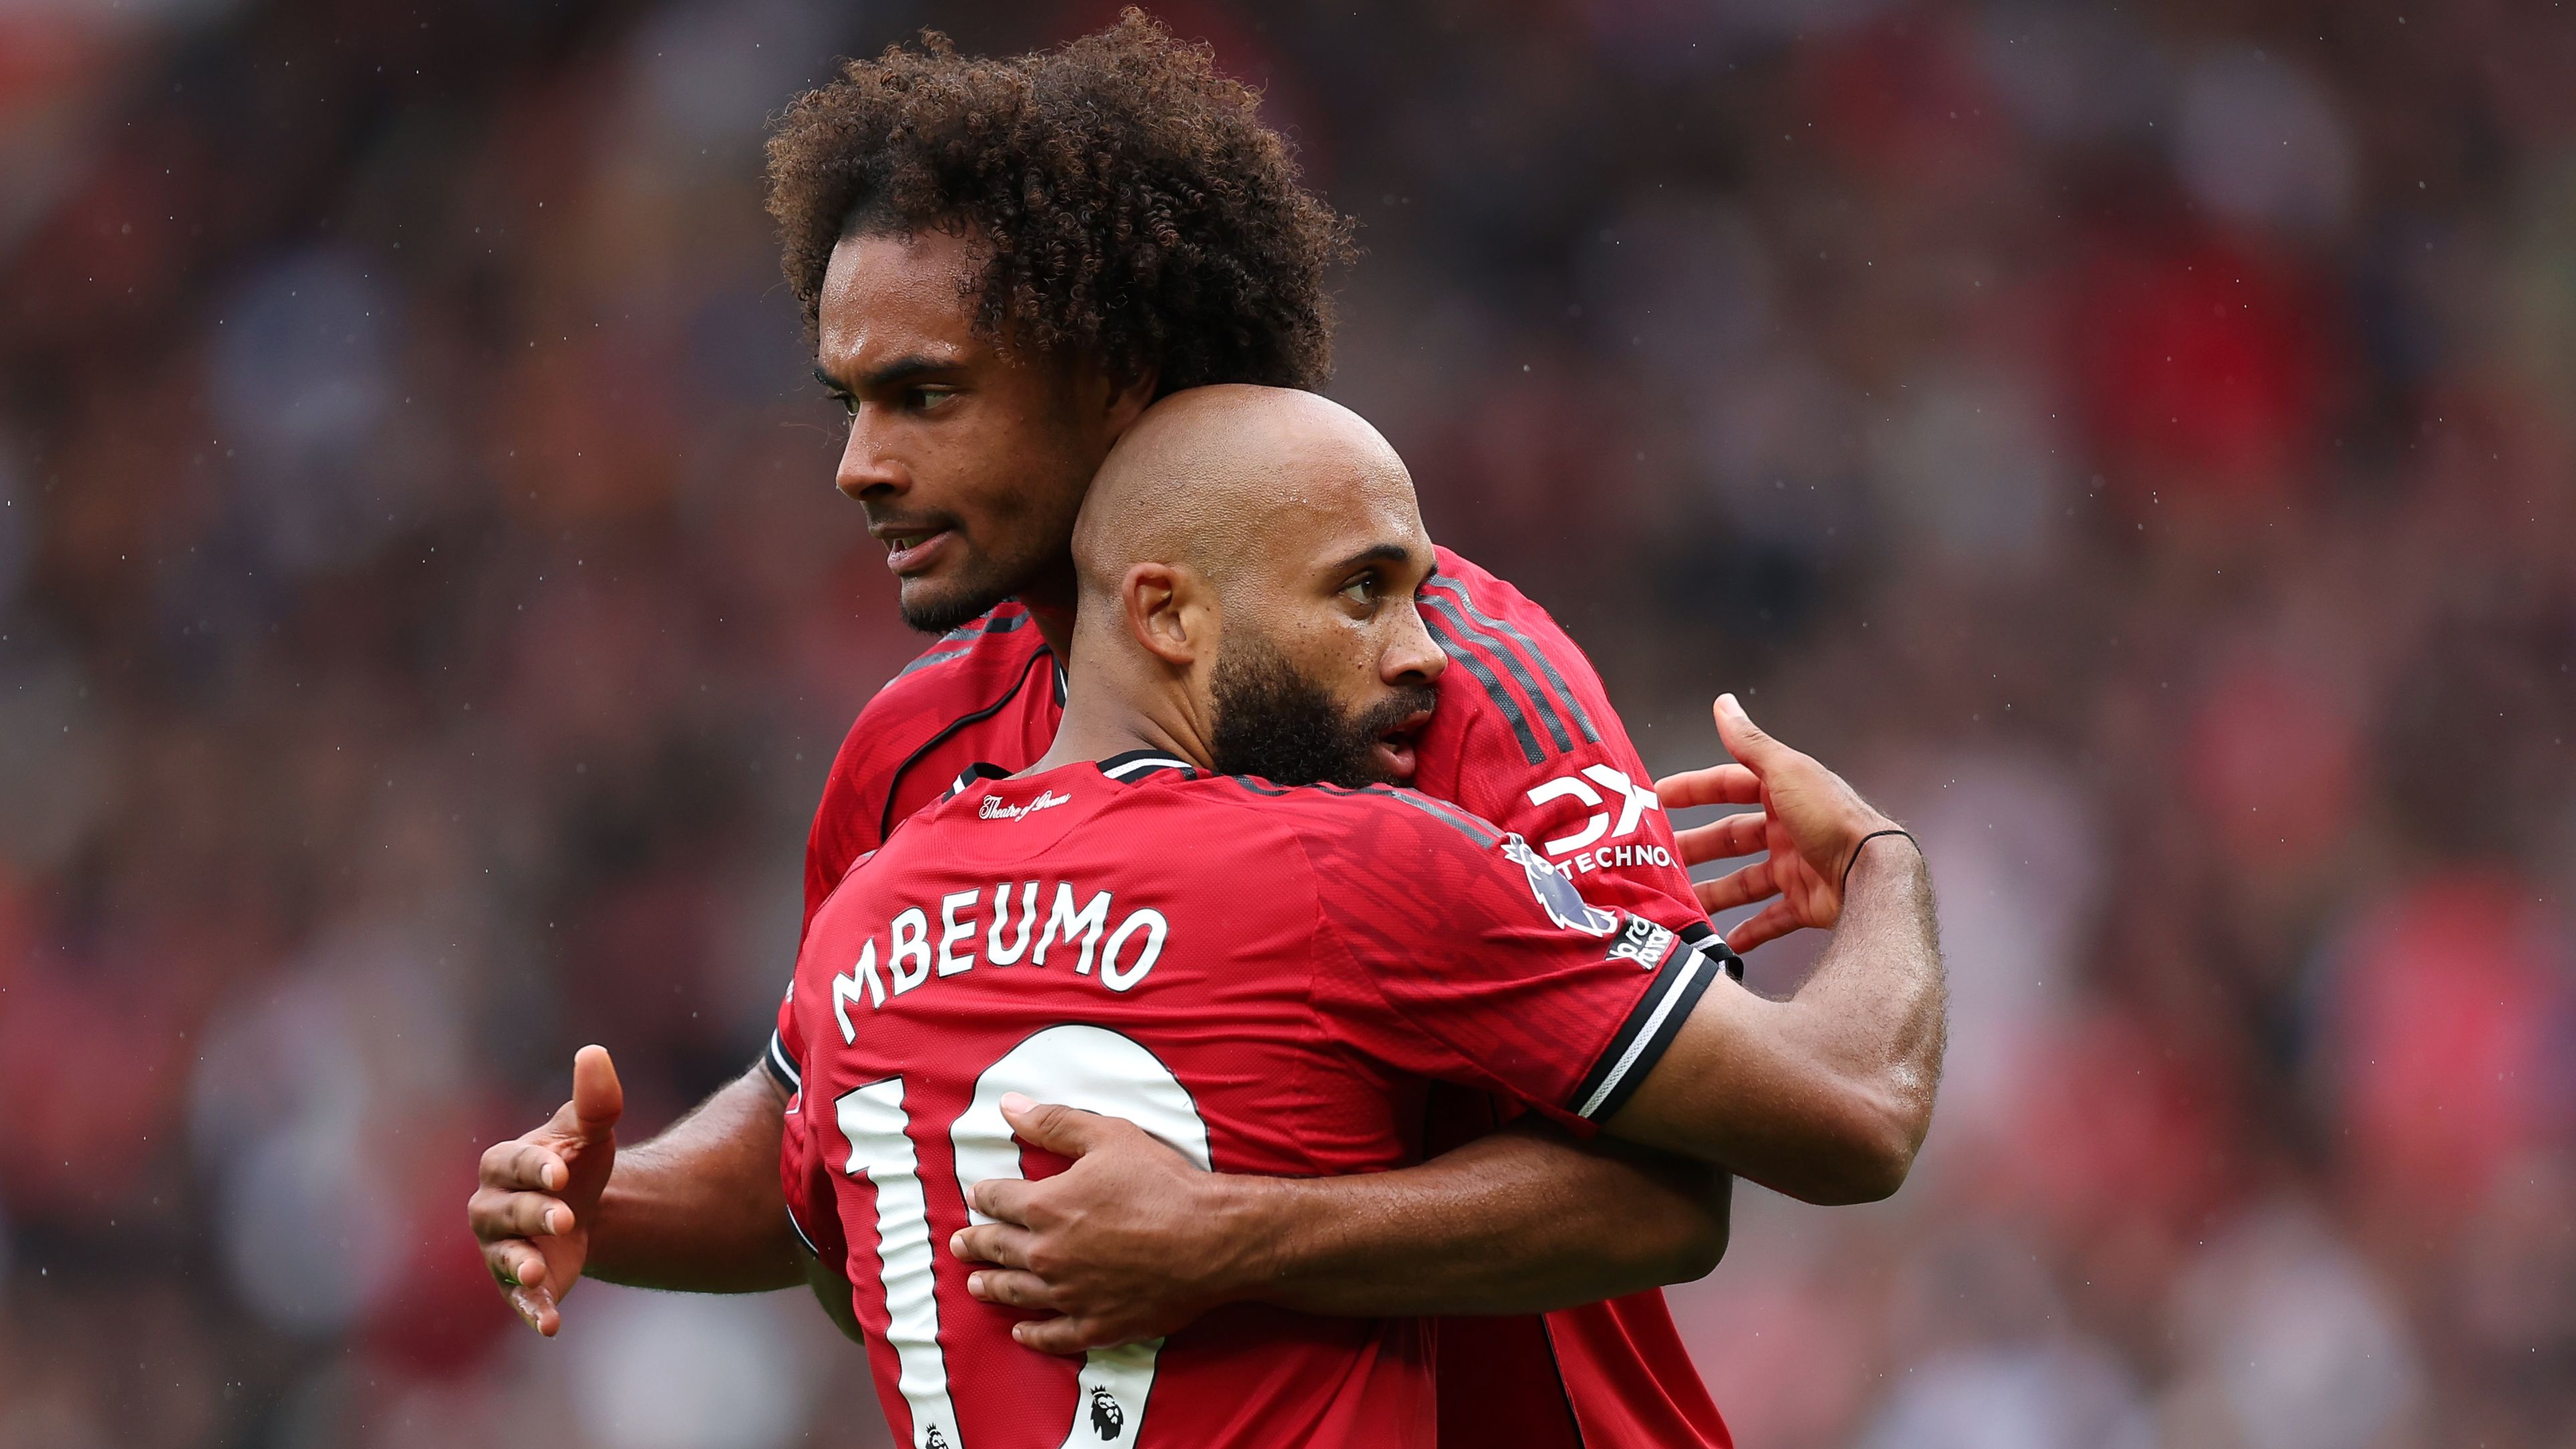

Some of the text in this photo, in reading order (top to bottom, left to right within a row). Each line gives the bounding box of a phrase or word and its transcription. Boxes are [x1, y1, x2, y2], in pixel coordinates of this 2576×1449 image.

[979, 795, 1020, 820] Theatre
[1014, 795, 1040, 822] of
[1554, 845, 1679, 881] TECHNO
[832, 881, 1169, 1046] MBEUMO
